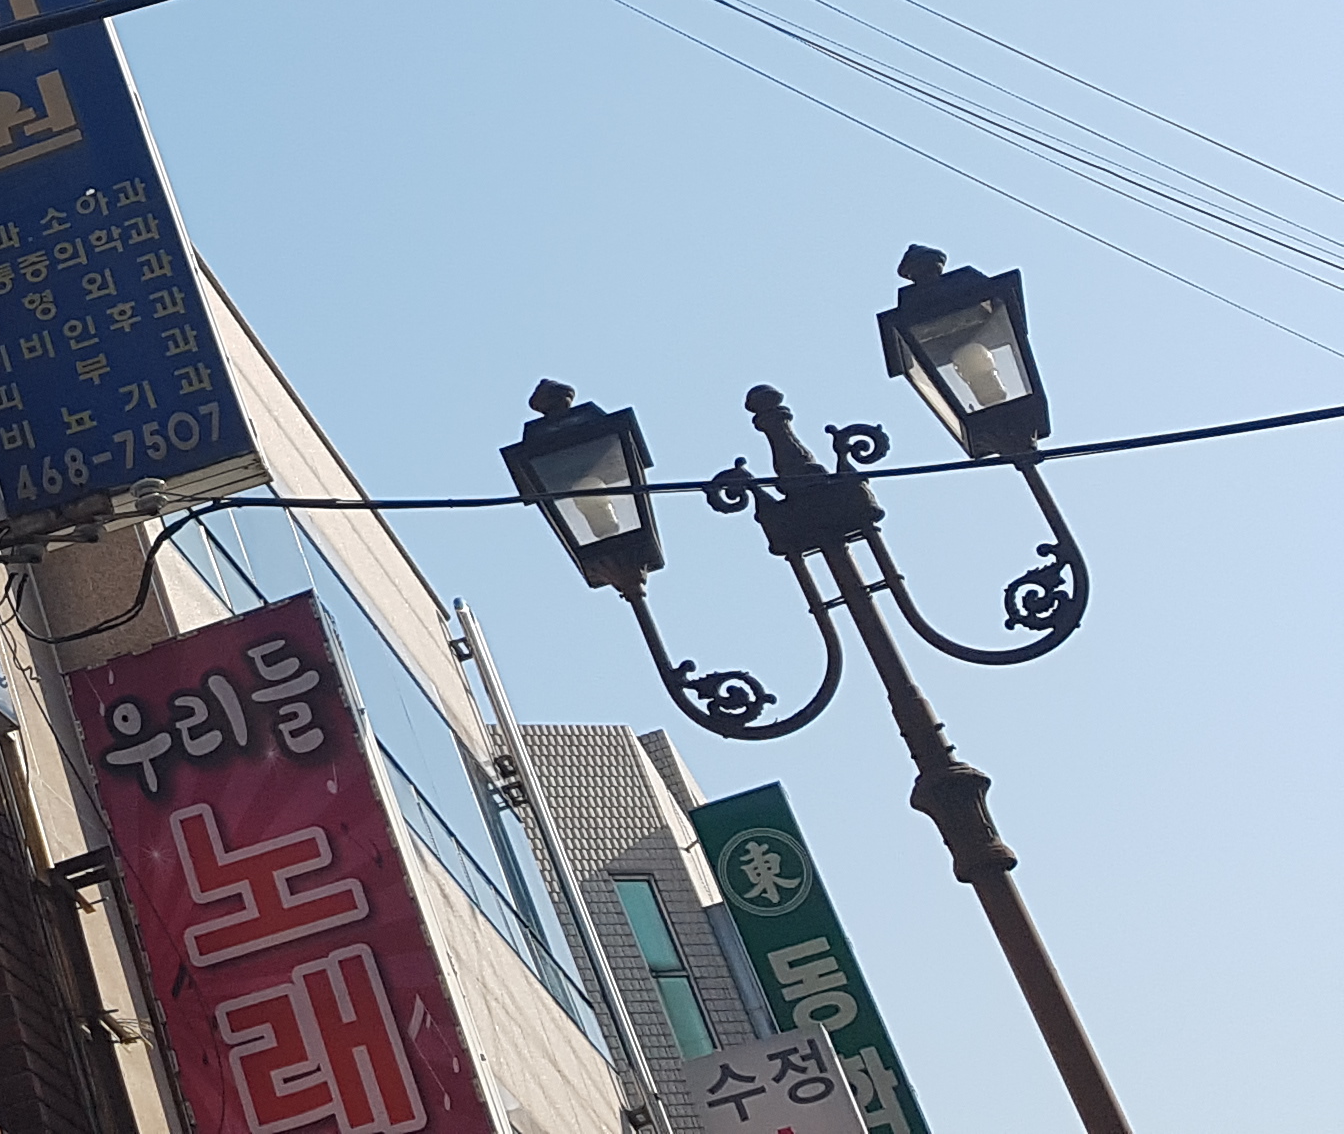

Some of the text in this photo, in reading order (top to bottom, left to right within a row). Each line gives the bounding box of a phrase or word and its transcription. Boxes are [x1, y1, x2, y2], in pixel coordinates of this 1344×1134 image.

[15, 401, 223, 502] 468-7507
[105, 638, 325, 793] 우리들
[738, 839, 803, 905] 東
[169, 802, 429, 1134] 노래
[705, 1038, 837, 1123] 수정
